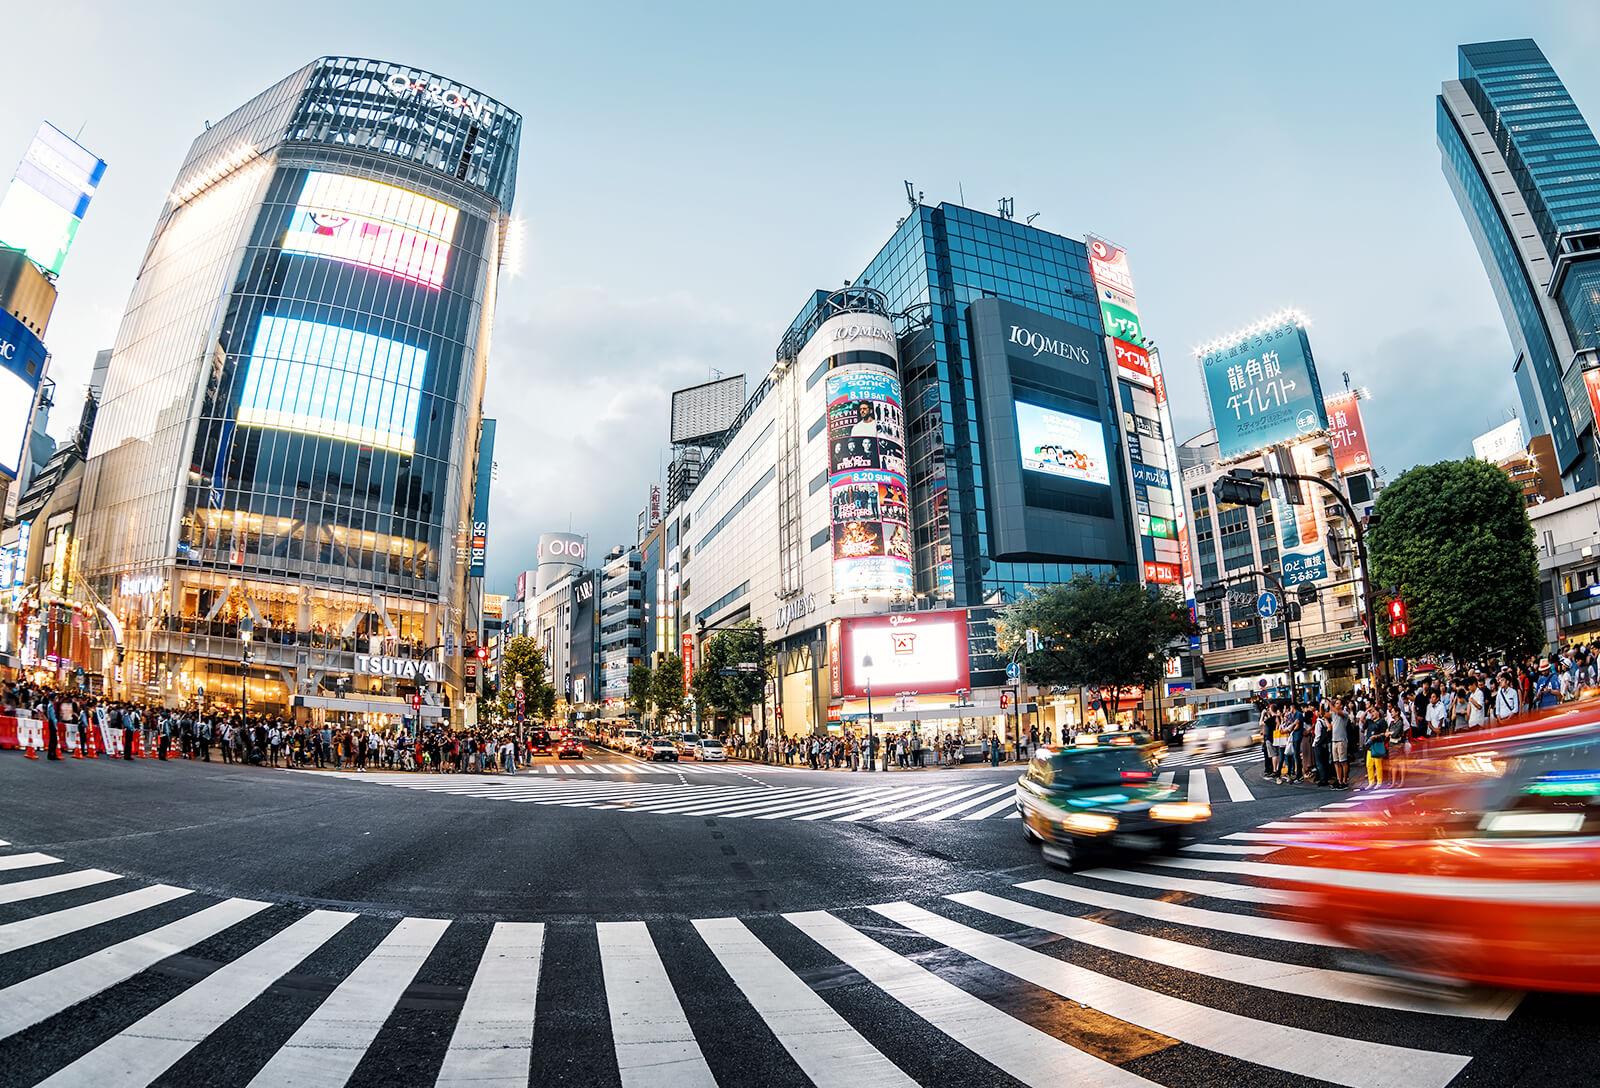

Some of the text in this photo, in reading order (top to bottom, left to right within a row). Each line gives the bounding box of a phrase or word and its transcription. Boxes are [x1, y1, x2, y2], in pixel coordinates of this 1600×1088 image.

[1106, 312, 1138, 335] レイク
[1115, 345, 1149, 369] アイフル
[1226, 350, 1282, 392] 龍角散
[847, 380, 886, 389] SONIC
[850, 390, 886, 401] 8.19 SAT
[1226, 378, 1296, 420] ダイレクト
[852, 472, 892, 482] 8.20 SUN
[1147, 566, 1172, 580] アコム
[1289, 568, 1322, 584] うるおう
[889, 616, 916, 627] Glico
[1340, 632, 1352, 642] JR
[358, 655, 434, 682] TSUTAYA
